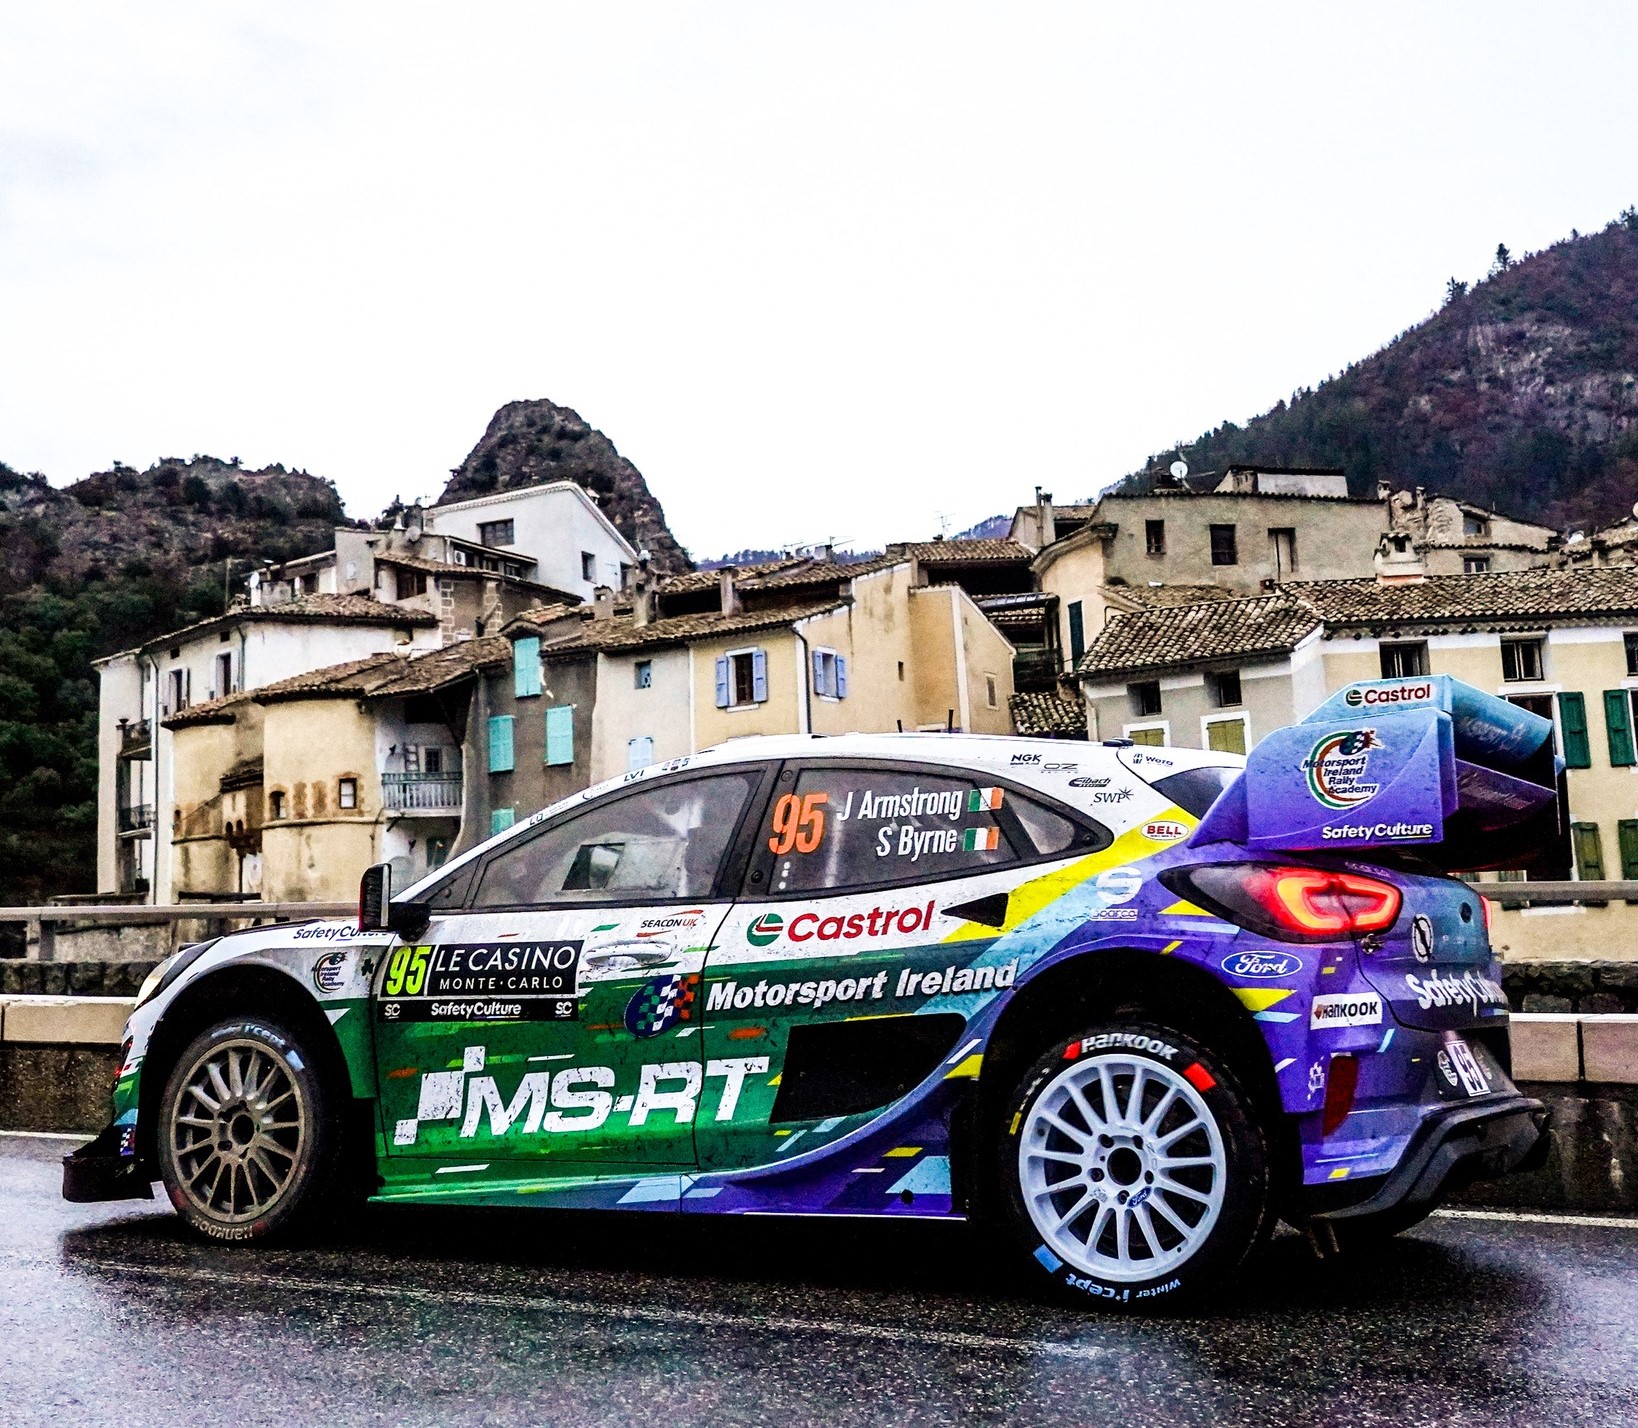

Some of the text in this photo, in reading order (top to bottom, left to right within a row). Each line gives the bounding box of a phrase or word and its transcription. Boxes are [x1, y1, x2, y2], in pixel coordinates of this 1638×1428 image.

[1364, 684, 1431, 704] Castrol
[1011, 753, 1042, 762] NGK
[1302, 756, 1366, 769] Motorsport
[1324, 766, 1364, 776] Ireland
[1327, 784, 1378, 795] Academy
[1328, 776, 1355, 786] Rally
[1093, 792, 1127, 803] SWP
[768, 787, 963, 855] 95 J Armstrong
[1147, 825, 1182, 835] BELL
[1322, 822, 1433, 840] SafetyCulture
[876, 825, 957, 862] S Byrne
[788, 900, 935, 942] Castrol
[435, 946, 576, 972] LE CASINO
[1235, 953, 1288, 974] Ford
[386, 945, 432, 995] 95
[705, 957, 1020, 1011] Motorsport Ireland
[384, 1004, 401, 1016] SC
[431, 1002, 521, 1019] SafetyCulture
[555, 1001, 572, 1015] SC
[460, 1056, 770, 1138] MS-RT
